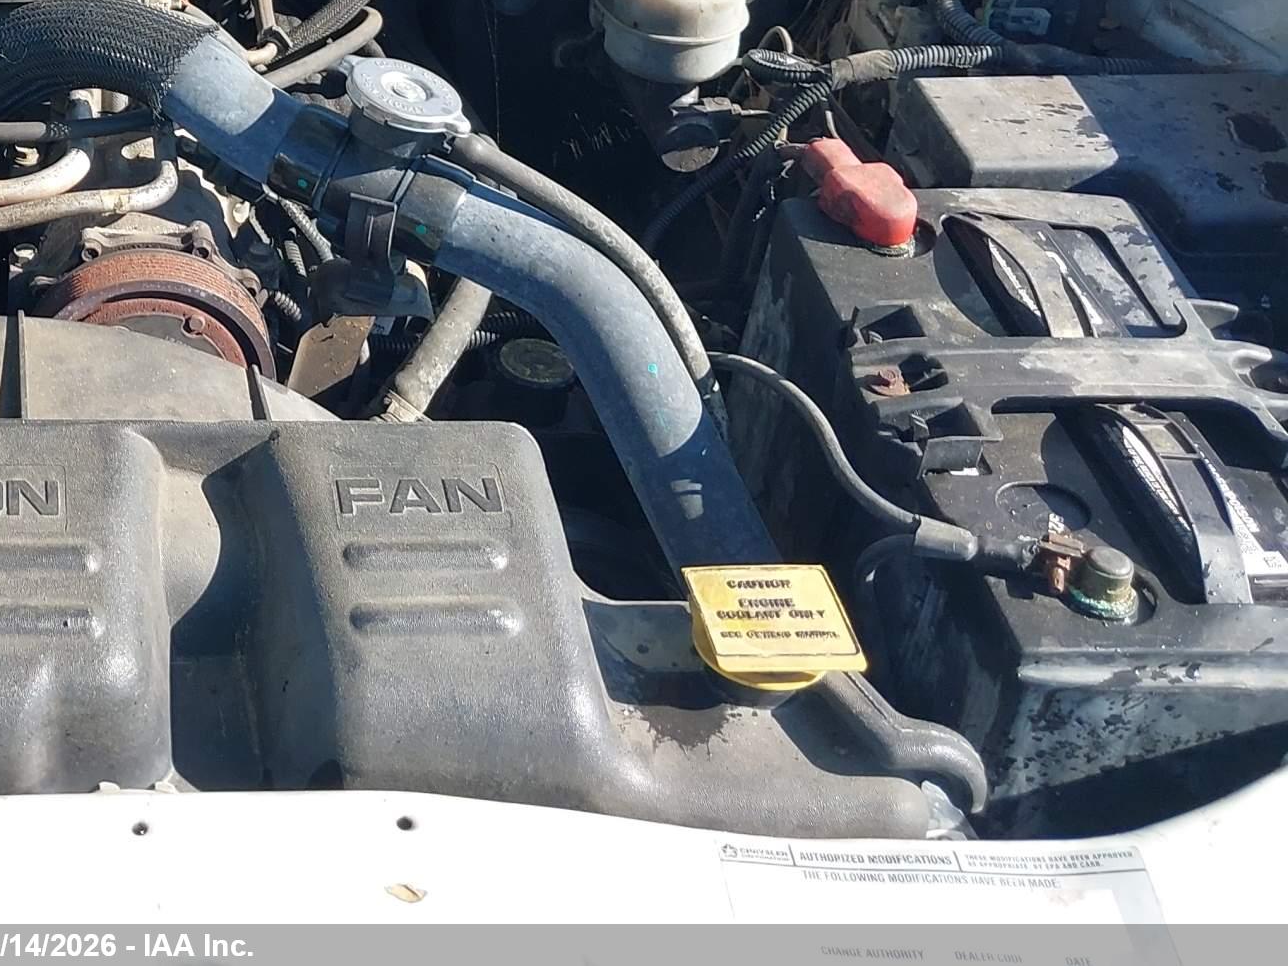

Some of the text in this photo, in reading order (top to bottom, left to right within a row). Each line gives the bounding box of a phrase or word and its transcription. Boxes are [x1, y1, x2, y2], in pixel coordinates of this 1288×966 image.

[335, 477, 505, 515] FAN
[726, 579, 792, 590] CAUTION
[738, 597, 796, 608] ENGINE
[716, 609, 826, 621] COOLANT ONLY
[799, 850, 953, 866] AUTHORIZED MODIFICATIONS
[802, 869, 821, 881] THE
[824, 870, 886, 883] FOLLOWING
[887, 872, 968, 886] MODIFICATIONS
[970, 875, 997, 887] HAVE
[820, 945, 926, 962] CHANGE AUTHORITY
